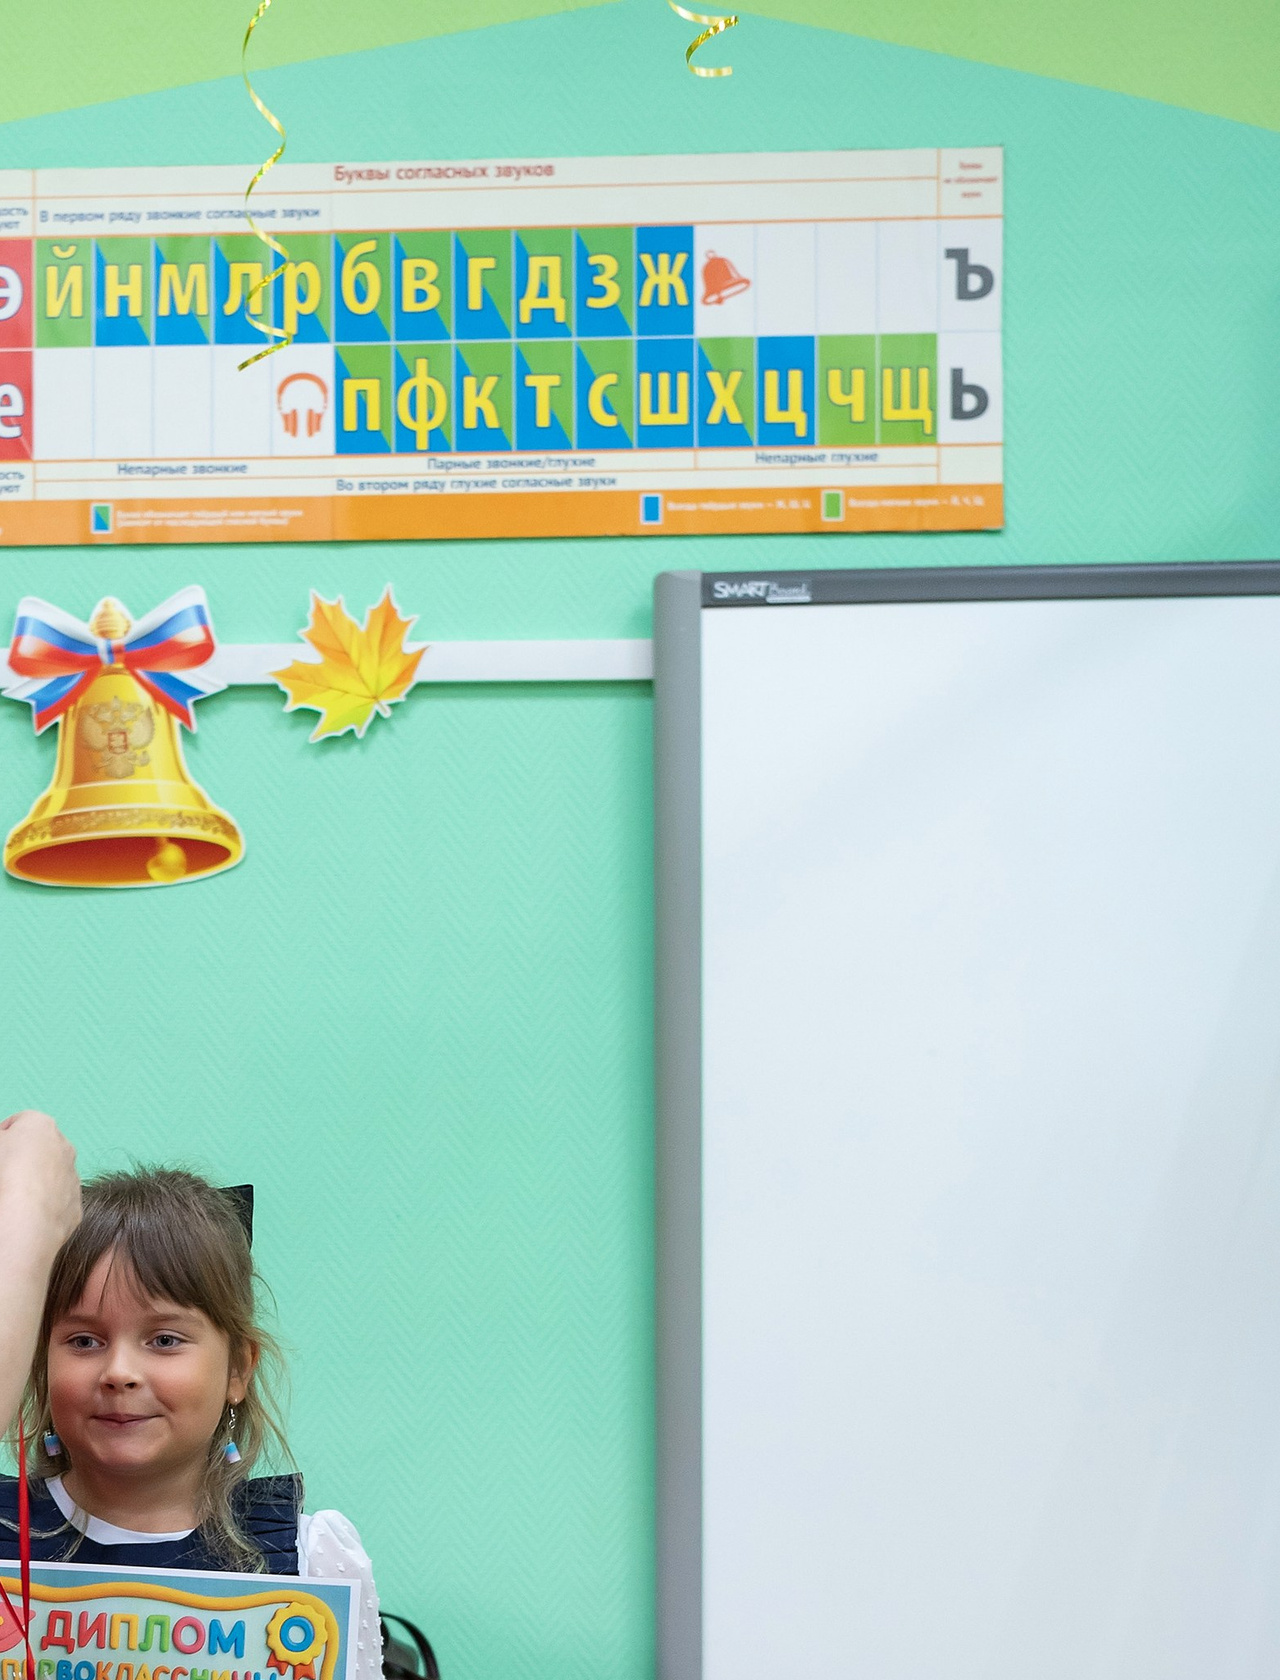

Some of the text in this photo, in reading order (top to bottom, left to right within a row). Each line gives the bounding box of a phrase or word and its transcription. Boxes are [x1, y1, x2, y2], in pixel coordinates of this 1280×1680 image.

[333, 163, 555, 185] Буквы согласных звуков
[39, 207, 321, 224] В первом ряду звонкие согласные звуки
[46, 245, 83, 317] й
[106, 265, 142, 316] н
[157, 263, 208, 315] м
[341, 239, 382, 315] б
[402, 257, 442, 312] в
[468, 257, 496, 309] г
[519, 255, 566, 323] д
[587, 253, 621, 308] з
[640, 253, 689, 306] ж
[343, 377, 381, 431] п
[396, 357, 448, 451] ф
[463, 375, 502, 428] к
[525, 374, 562, 427] т
[587, 372, 619, 427] с
[640, 371, 690, 425] ш
[706, 369, 744, 424] х
[765, 369, 807, 437] ц
[827, 367, 866, 422] ч
[881, 366, 934, 435] щ
[950, 367, 990, 422] ь
[427, 455, 596, 472] Парные звонкие/глухие
[755, 450, 879, 466] Непарные глухие
[118, 462, 248, 477] Непарные звонкие
[335, 475, 617, 493] Во втором ряду глухие согласные звуки
[713, 580, 769, 598] SMART
[39, 1609, 247, 1659] ДИПЛОМ
